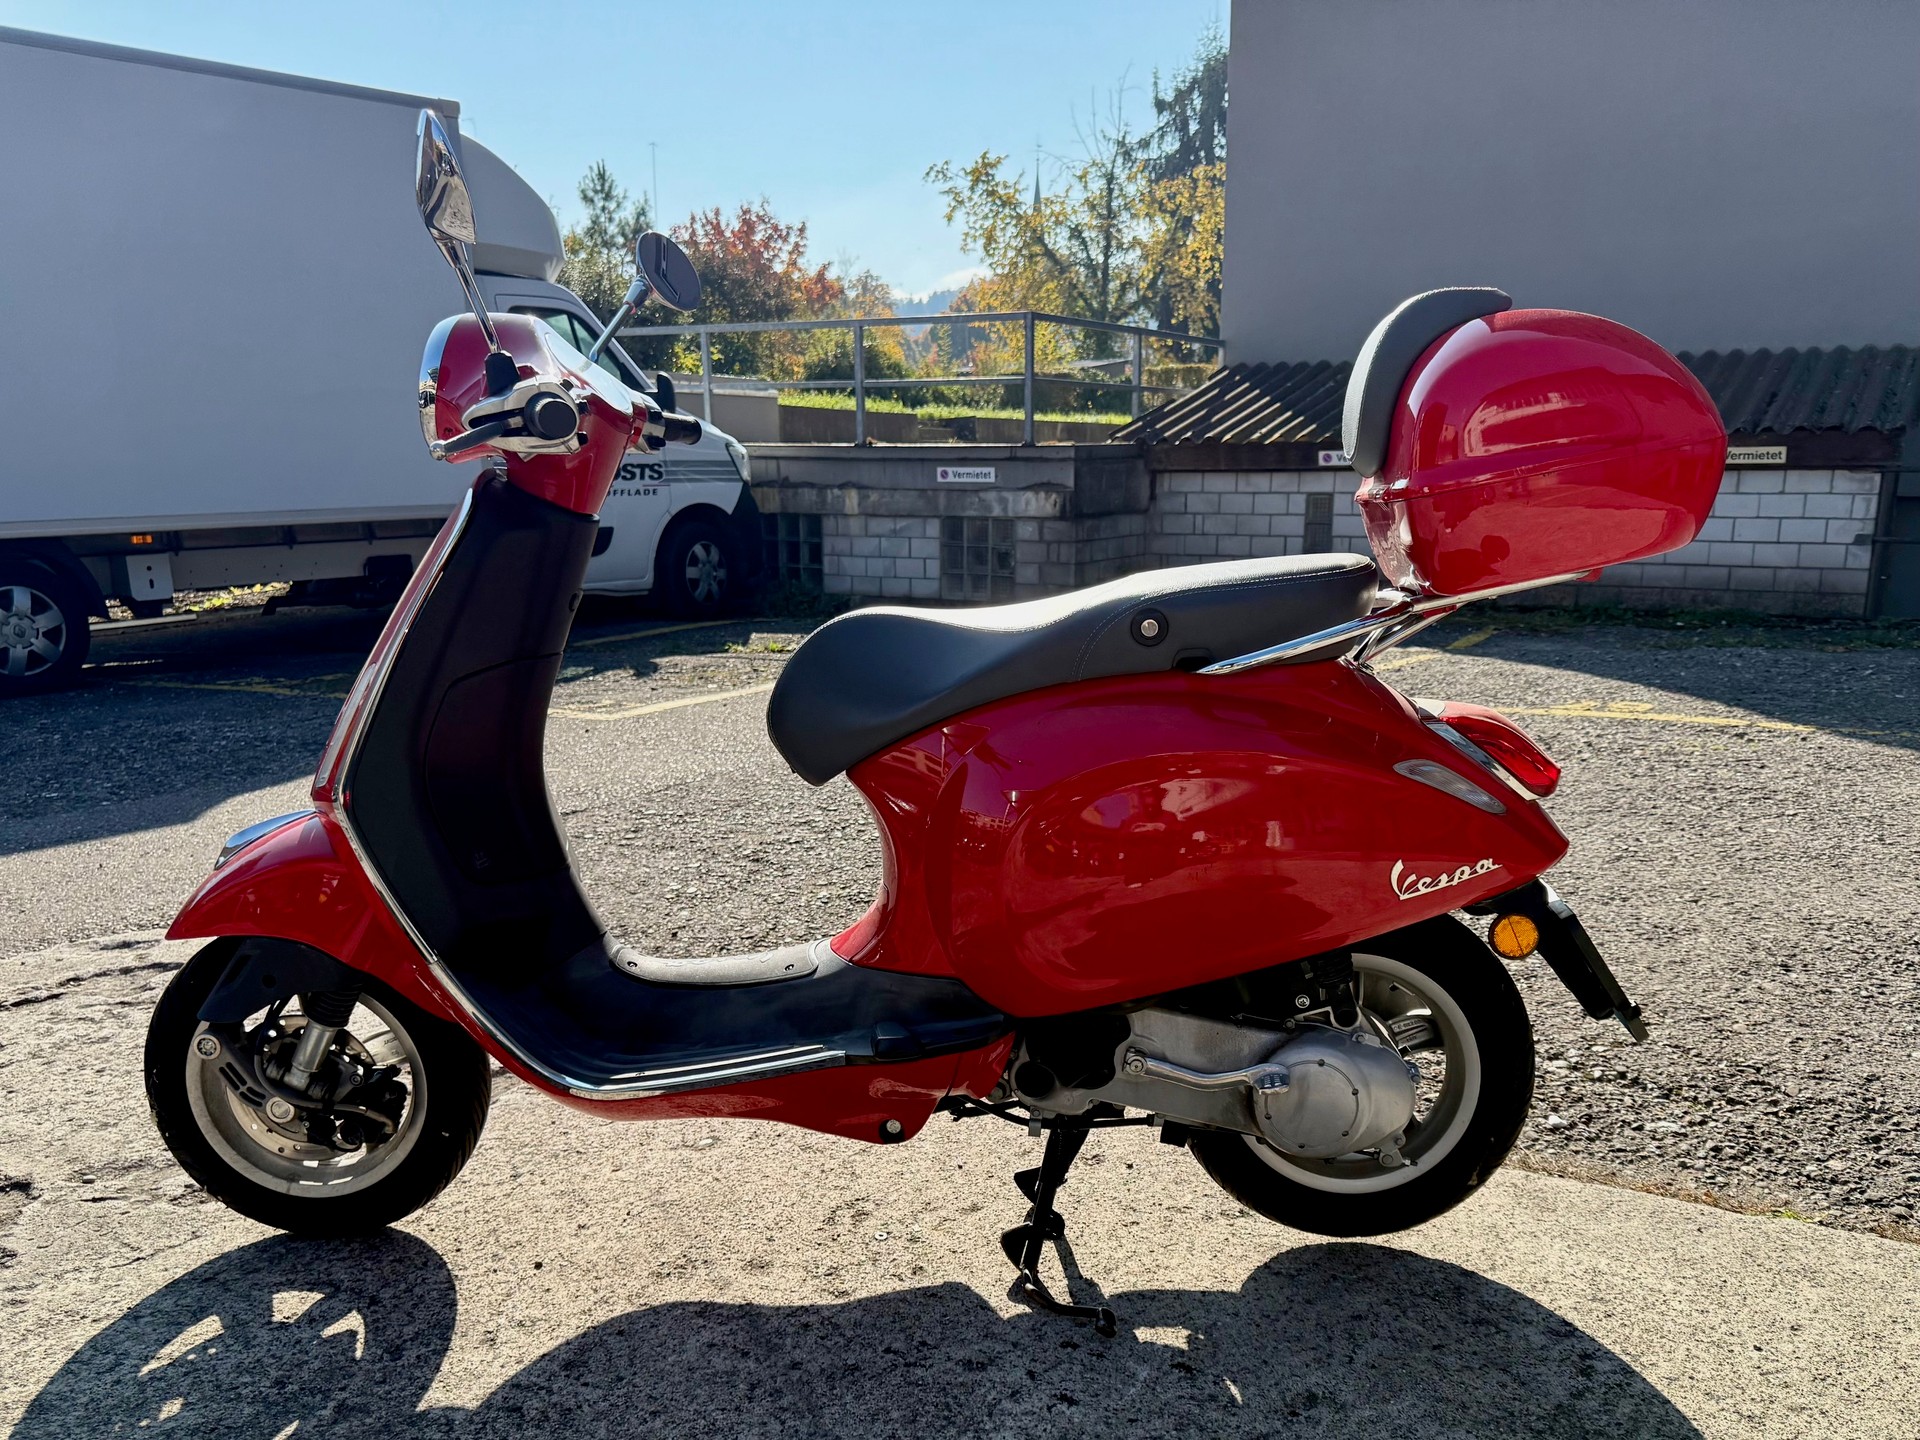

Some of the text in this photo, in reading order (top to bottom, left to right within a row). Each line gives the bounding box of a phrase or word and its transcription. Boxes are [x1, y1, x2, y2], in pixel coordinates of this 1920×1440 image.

[1726, 451, 1782, 461] Vermietet
[952, 470, 991, 480] Vermietet
[1391, 858, 1503, 900] Vespa
